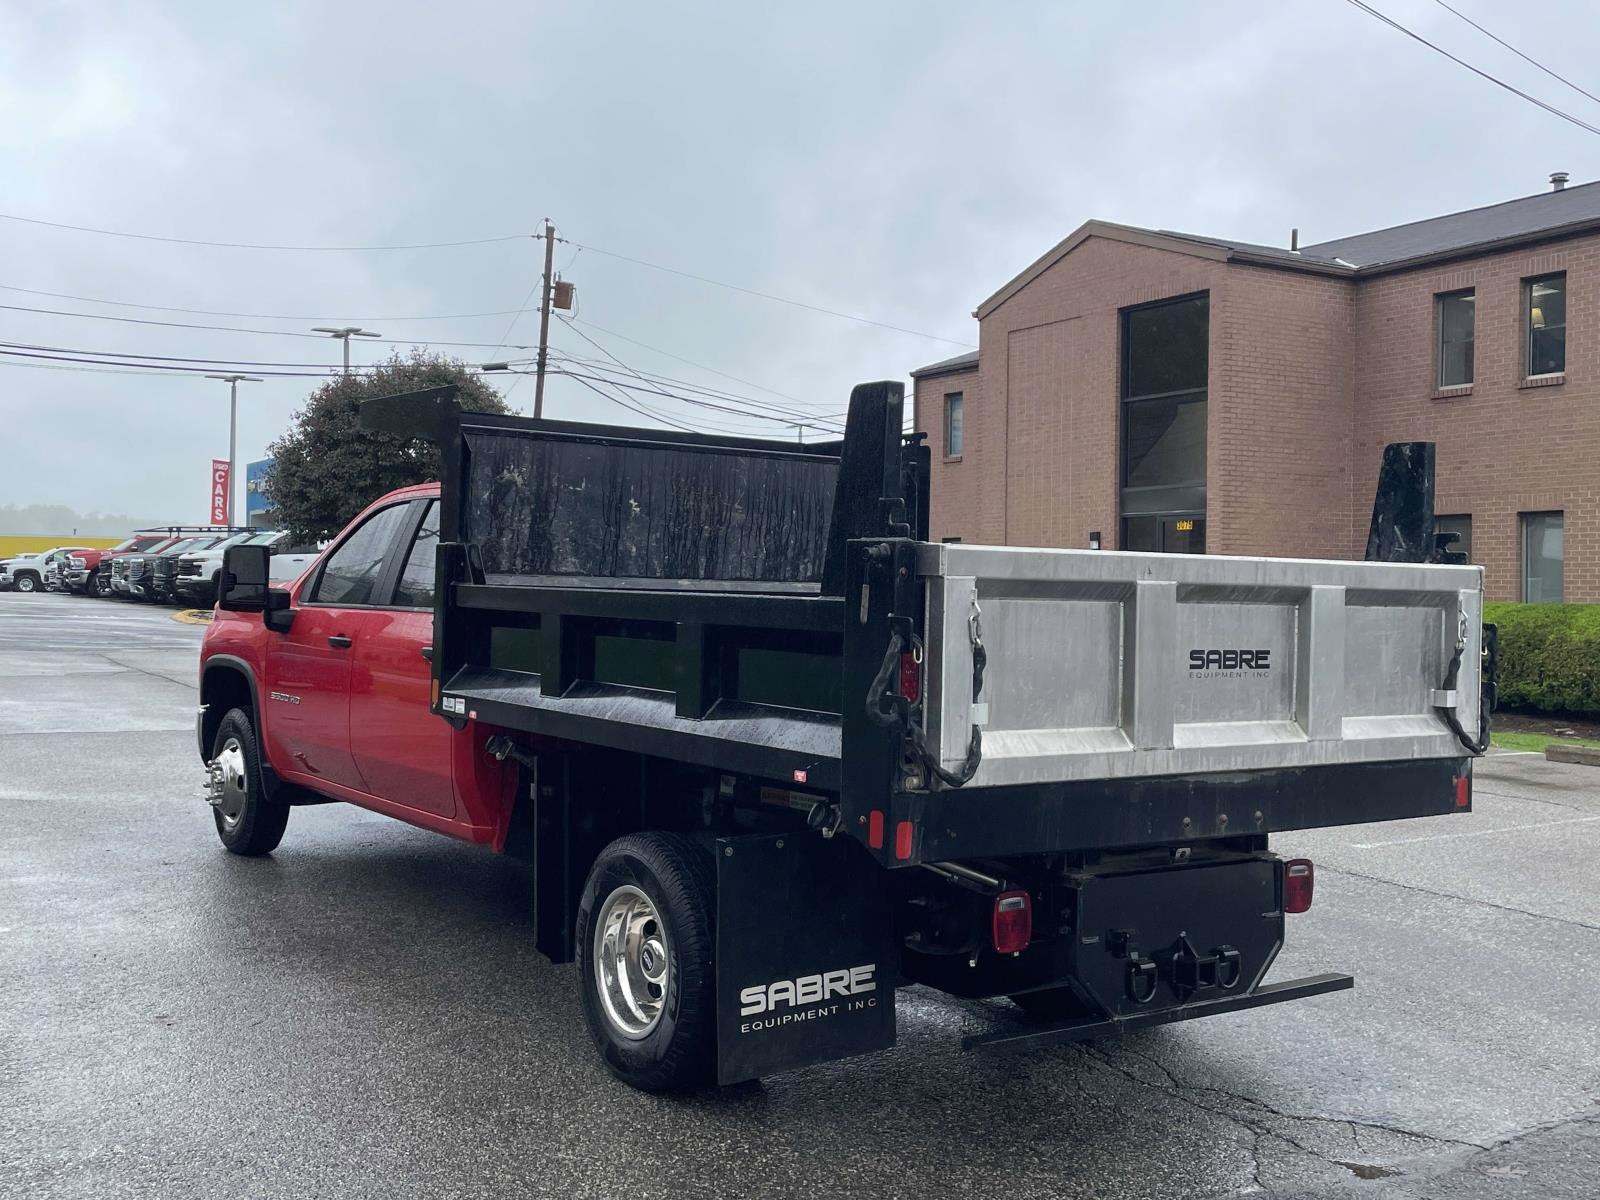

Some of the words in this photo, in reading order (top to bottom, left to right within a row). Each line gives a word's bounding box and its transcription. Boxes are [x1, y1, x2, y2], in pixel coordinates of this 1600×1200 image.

[214, 471, 226, 521] CARS
[1189, 649, 1271, 670] SABRE
[1189, 671, 1248, 679] EQUIPMENT
[740, 963, 877, 1017] SABRE
[741, 1005, 839, 1034] EQUIPMENT
[848, 997, 877, 1011] INC
